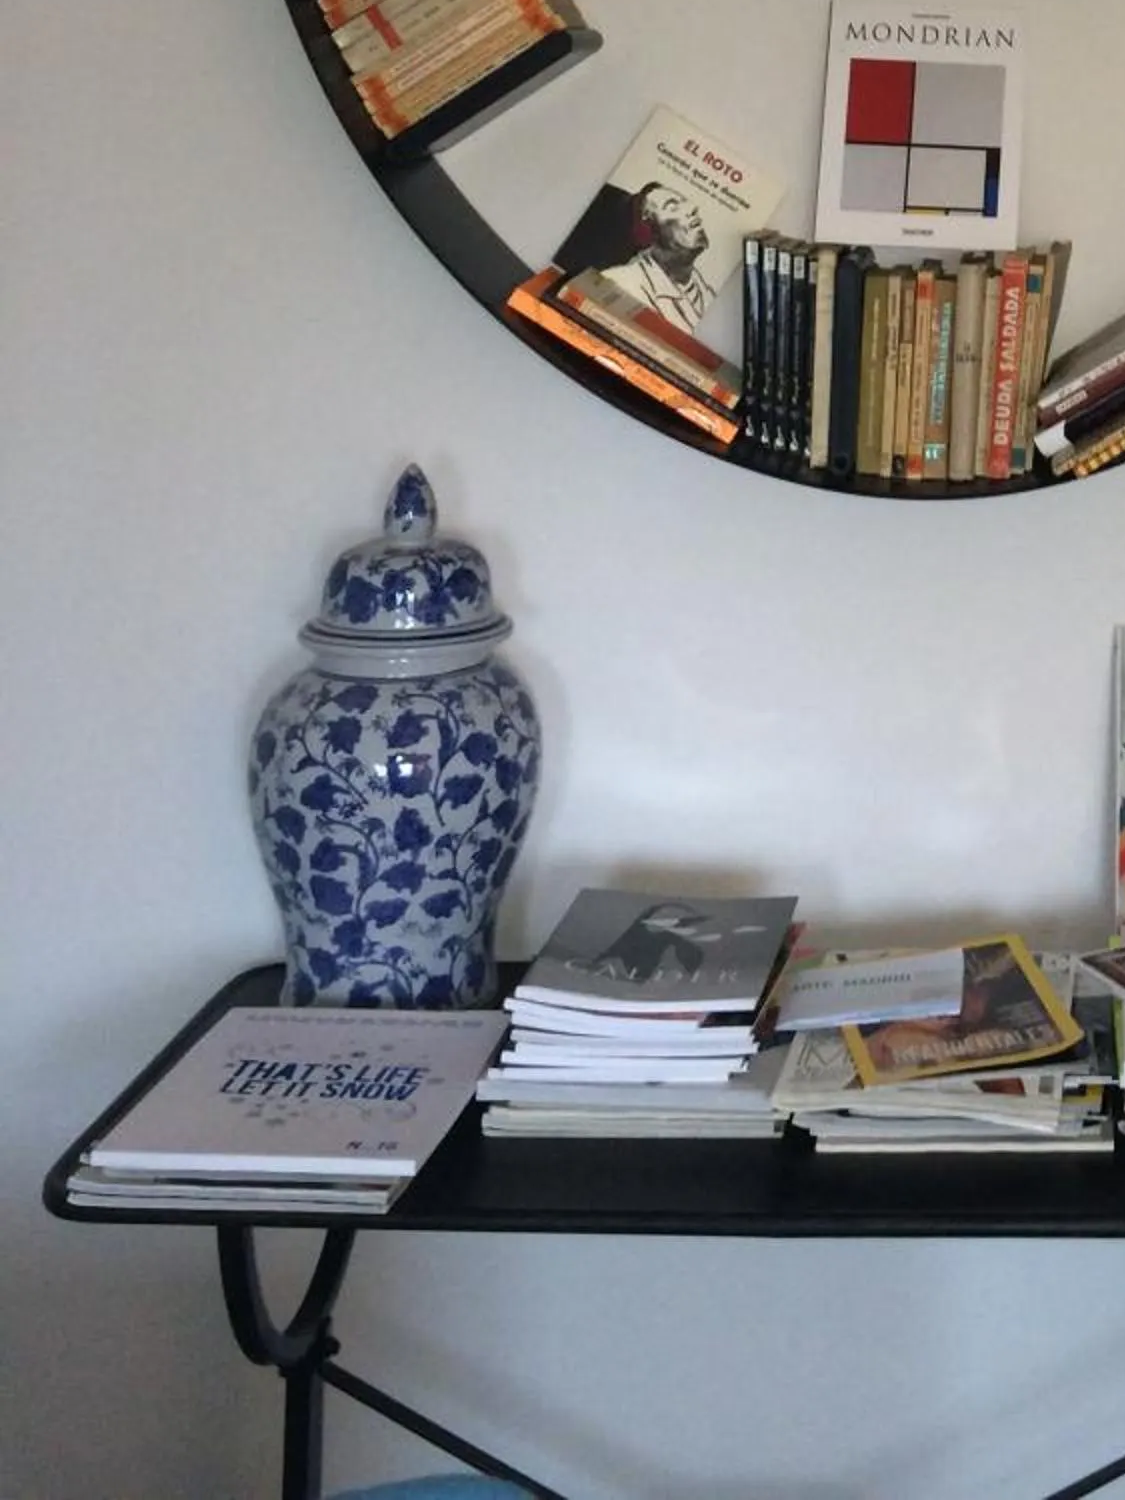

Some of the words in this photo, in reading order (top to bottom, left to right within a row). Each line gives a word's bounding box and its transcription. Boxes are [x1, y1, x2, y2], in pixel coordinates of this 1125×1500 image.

[845, 22, 1015, 49] MONDRIAN
[683, 139, 700, 157] EL
[702, 151, 743, 183] ROTO
[1000, 286, 1021, 373] SALDADA
[994, 379, 1013, 446] DEUDA
[220, 1077, 279, 1097] LET
[320, 1081, 420, 1101] SNOW
[233, 1059, 352, 1083] THAT'S
[353, 1064, 426, 1085] LIFE
